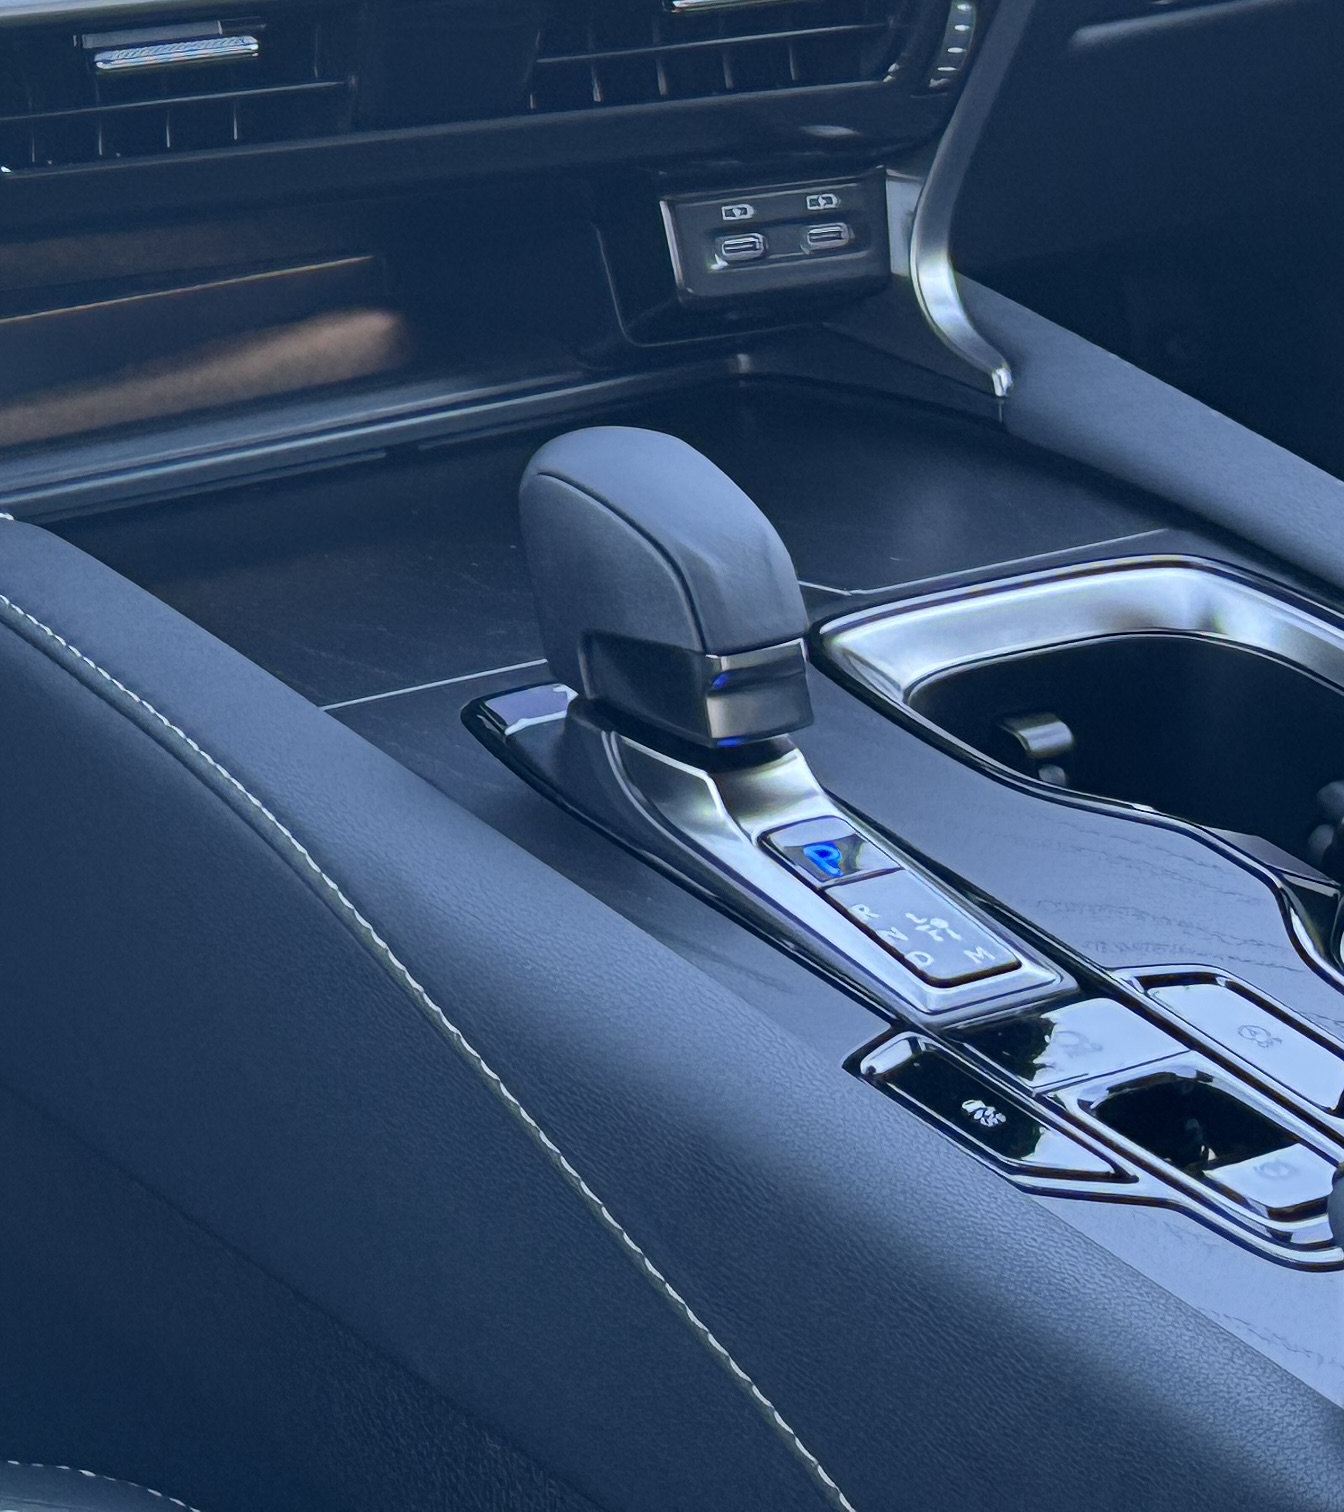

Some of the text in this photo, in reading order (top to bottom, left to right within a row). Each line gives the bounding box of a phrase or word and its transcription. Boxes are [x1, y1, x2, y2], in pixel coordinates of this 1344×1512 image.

[803, 843, 843, 878] P
[848, 903, 880, 925] R
[964, 946, 996, 964] M
